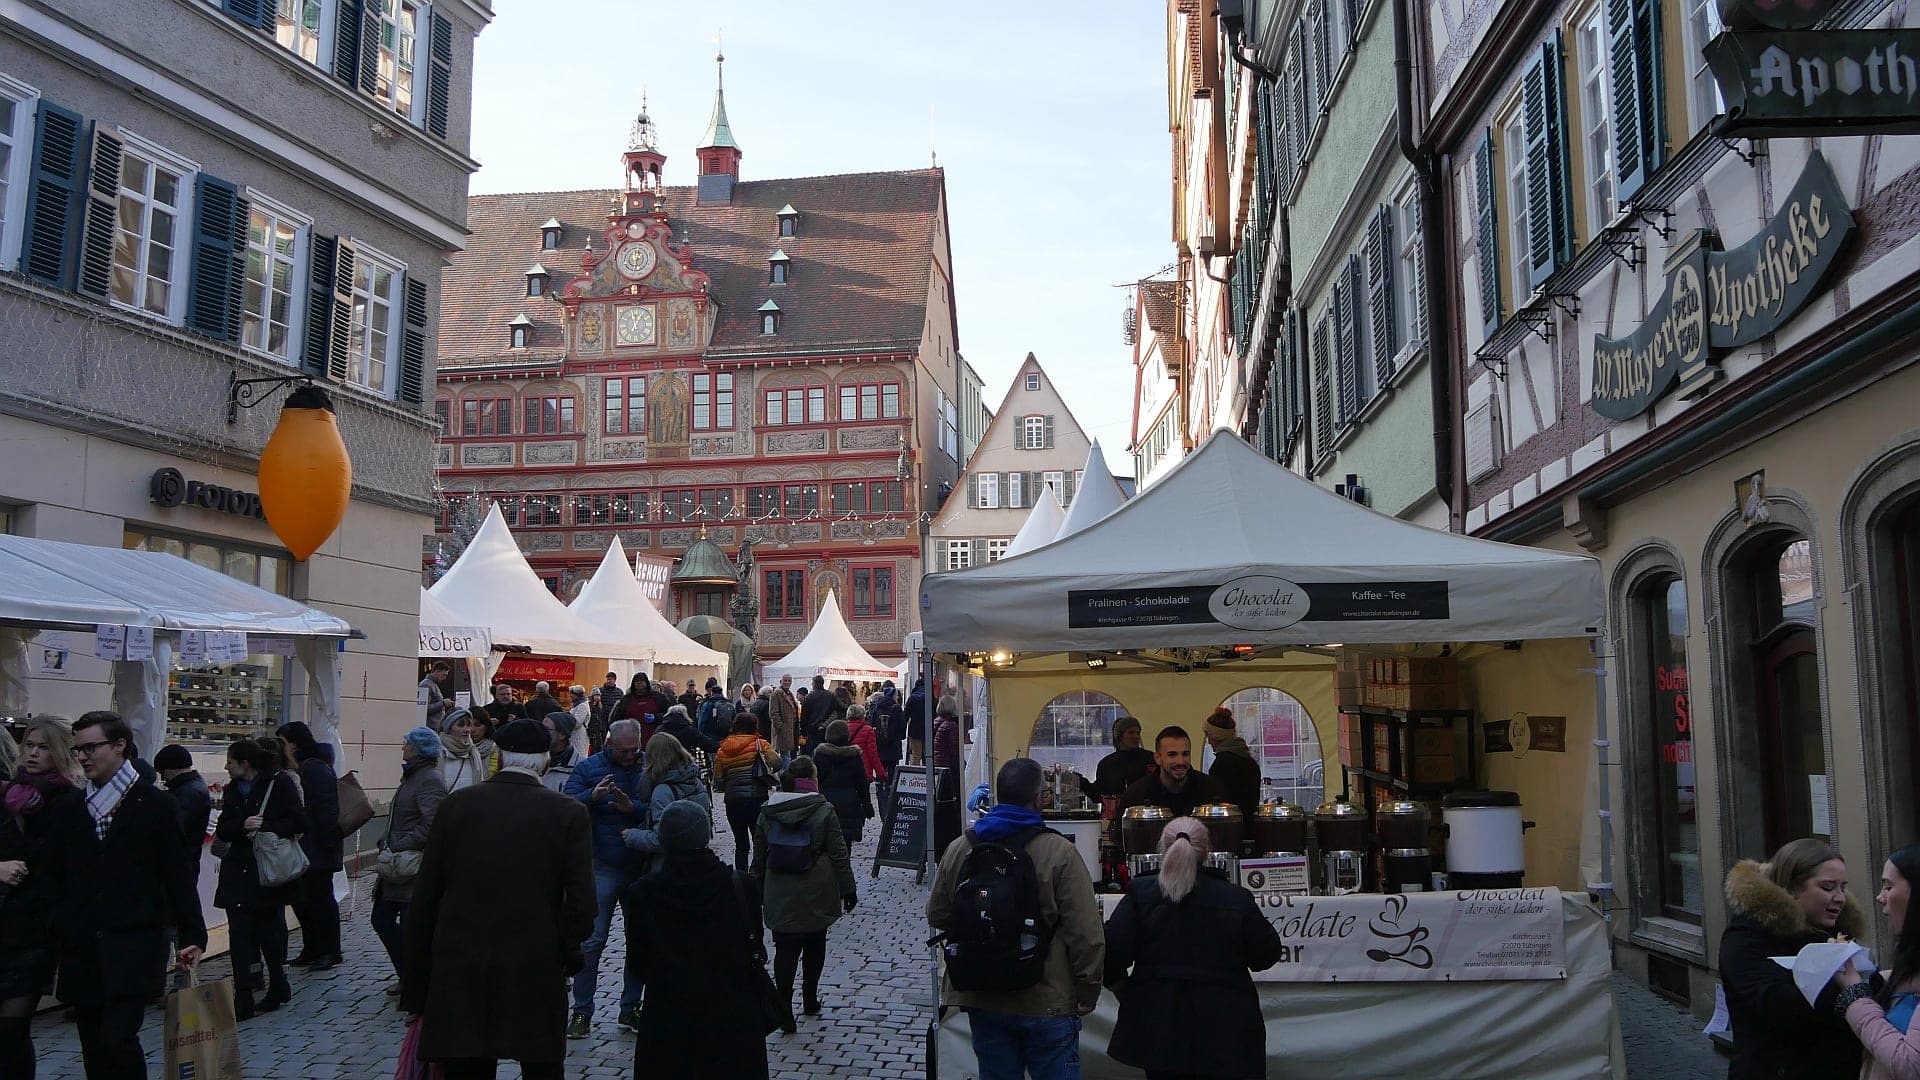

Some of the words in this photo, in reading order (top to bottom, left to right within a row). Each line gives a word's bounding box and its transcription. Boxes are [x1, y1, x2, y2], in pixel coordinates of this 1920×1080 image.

[1751, 41, 1917, 107] Apoth
[1708, 193, 1830, 341] Apotheke
[637, 563, 668, 582] SCHOKO
[1088, 598, 1127, 608] Pralinen
[1134, 595, 1190, 606] Schokolade
[1223, 587, 1294, 607] Chocolat
[1352, 590, 1382, 600] Kaffee
[1390, 590, 1406, 600] Tee
[419, 630, 472, 651] kobar
[1674, 693, 1690, 733] S
[1457, 889, 1545, 902] Chocolat
[1465, 902, 1482, 914] der
[1513, 902, 1543, 914] laden
[1502, 942, 1520, 950] 72070
[1522, 942, 1552, 951] Tübingen
